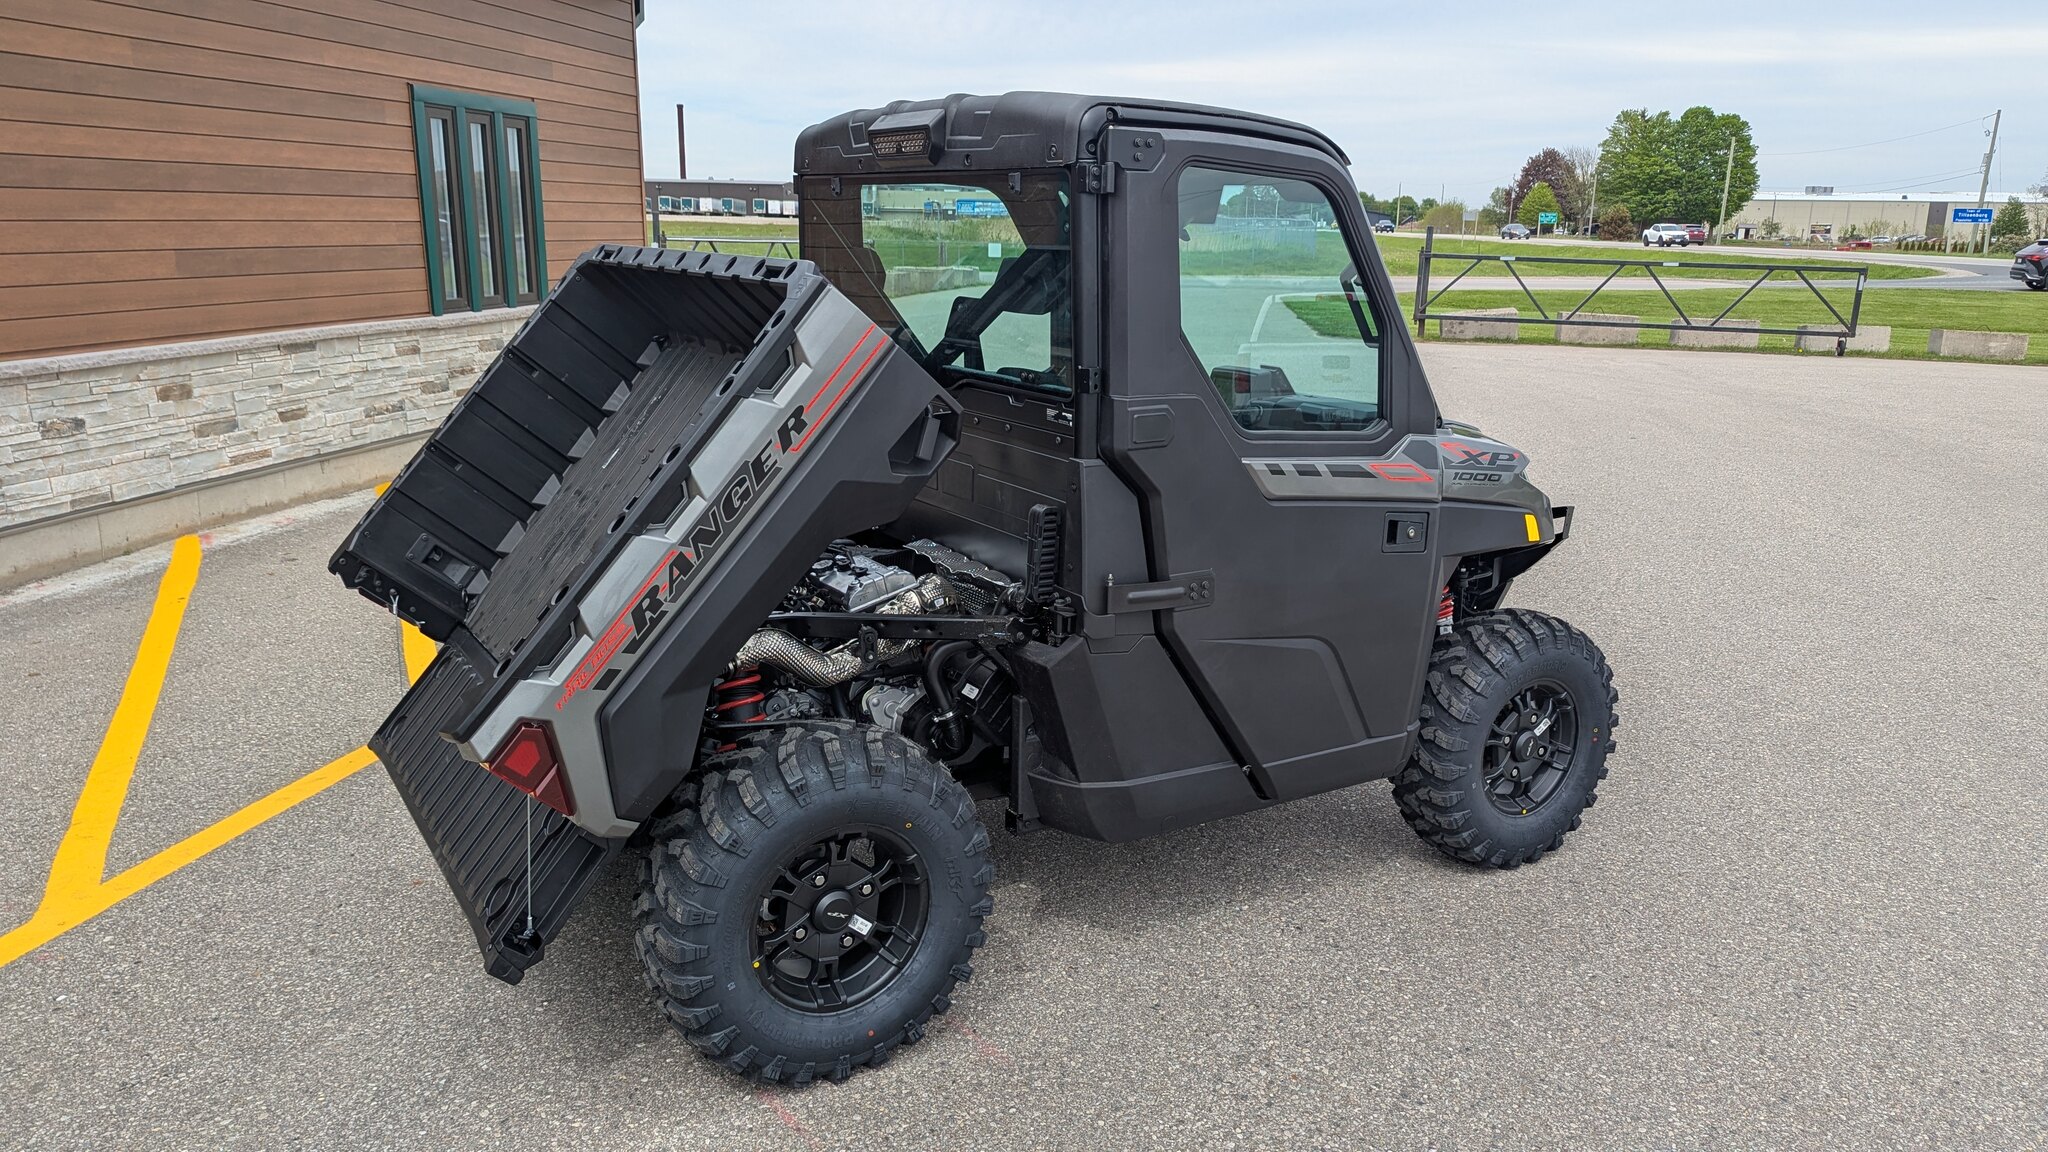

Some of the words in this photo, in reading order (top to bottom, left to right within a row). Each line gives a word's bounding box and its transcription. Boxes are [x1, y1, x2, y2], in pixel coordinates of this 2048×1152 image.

[1453, 450, 1517, 467] XP
[1452, 472, 1503, 482] 1000
[628, 403, 810, 640] RANGER
